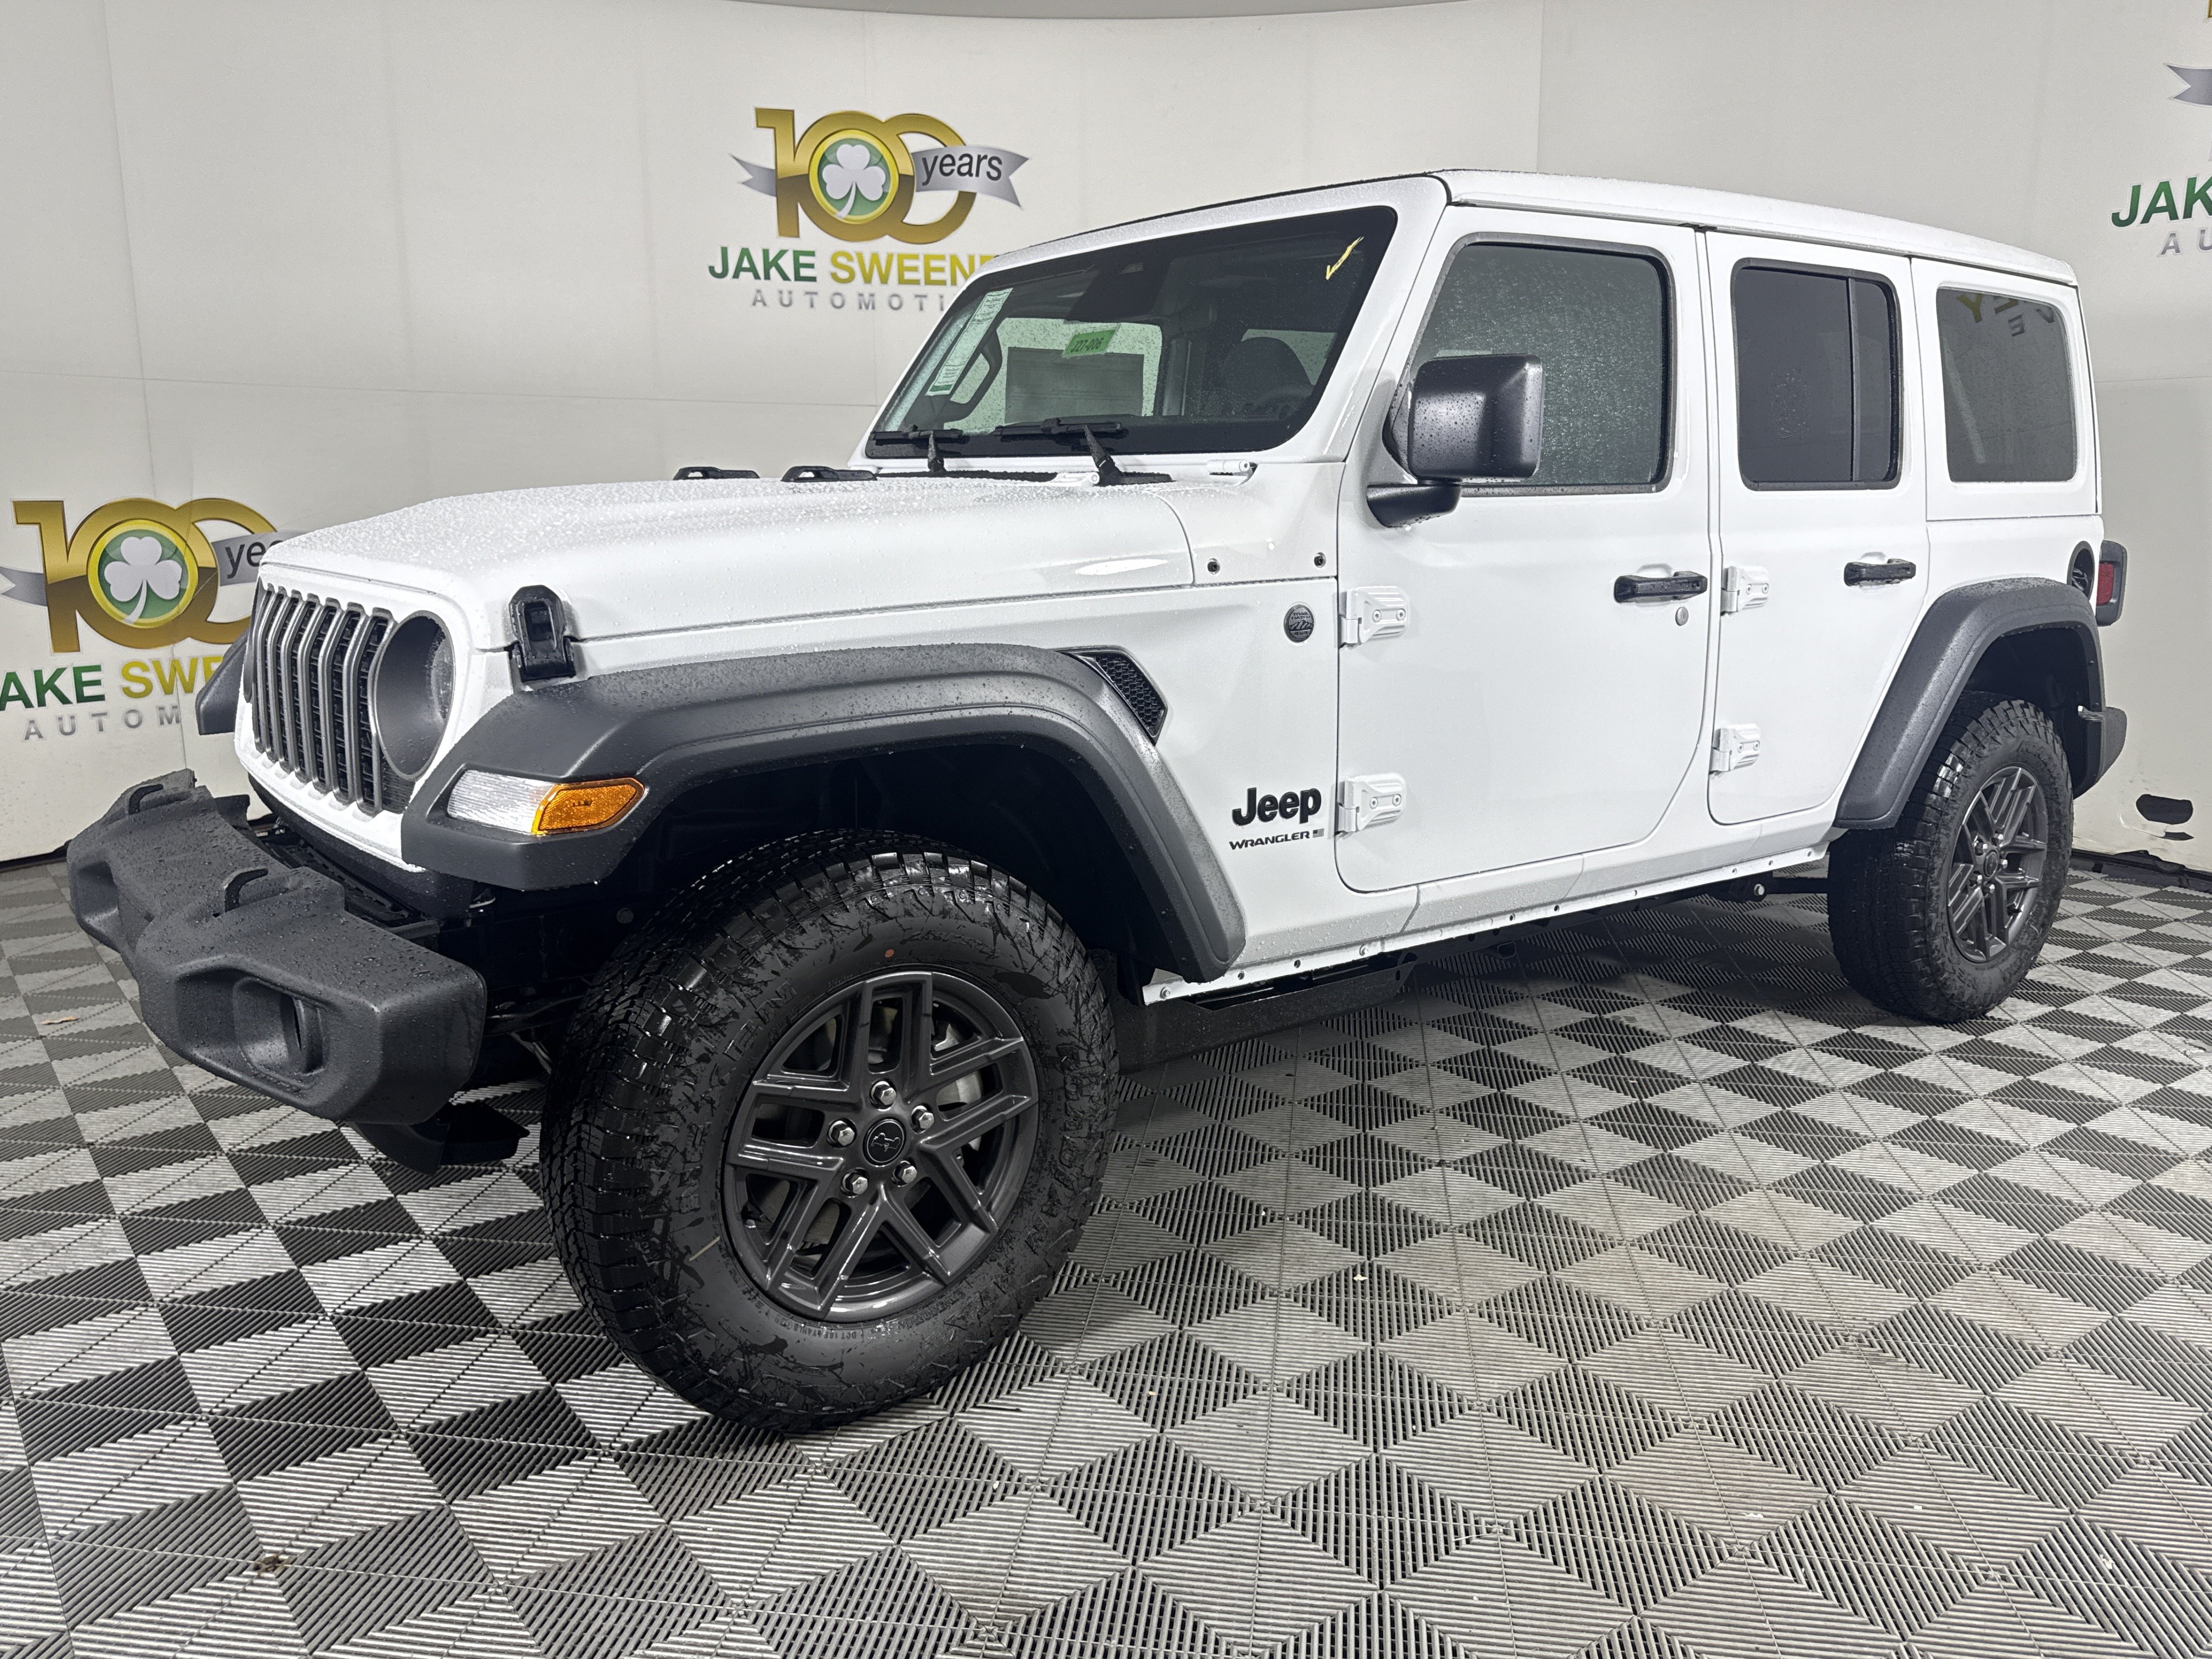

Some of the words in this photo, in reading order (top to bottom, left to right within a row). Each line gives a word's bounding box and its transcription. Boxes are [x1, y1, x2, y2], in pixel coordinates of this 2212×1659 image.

[921, 154, 1003, 185] years
[709, 246, 817, 282] JAKE
[1070, 337, 1104, 353] J27-006
[1232, 787, 1322, 826] Jeep
[1229, 831, 1310, 850] WRANGLER
